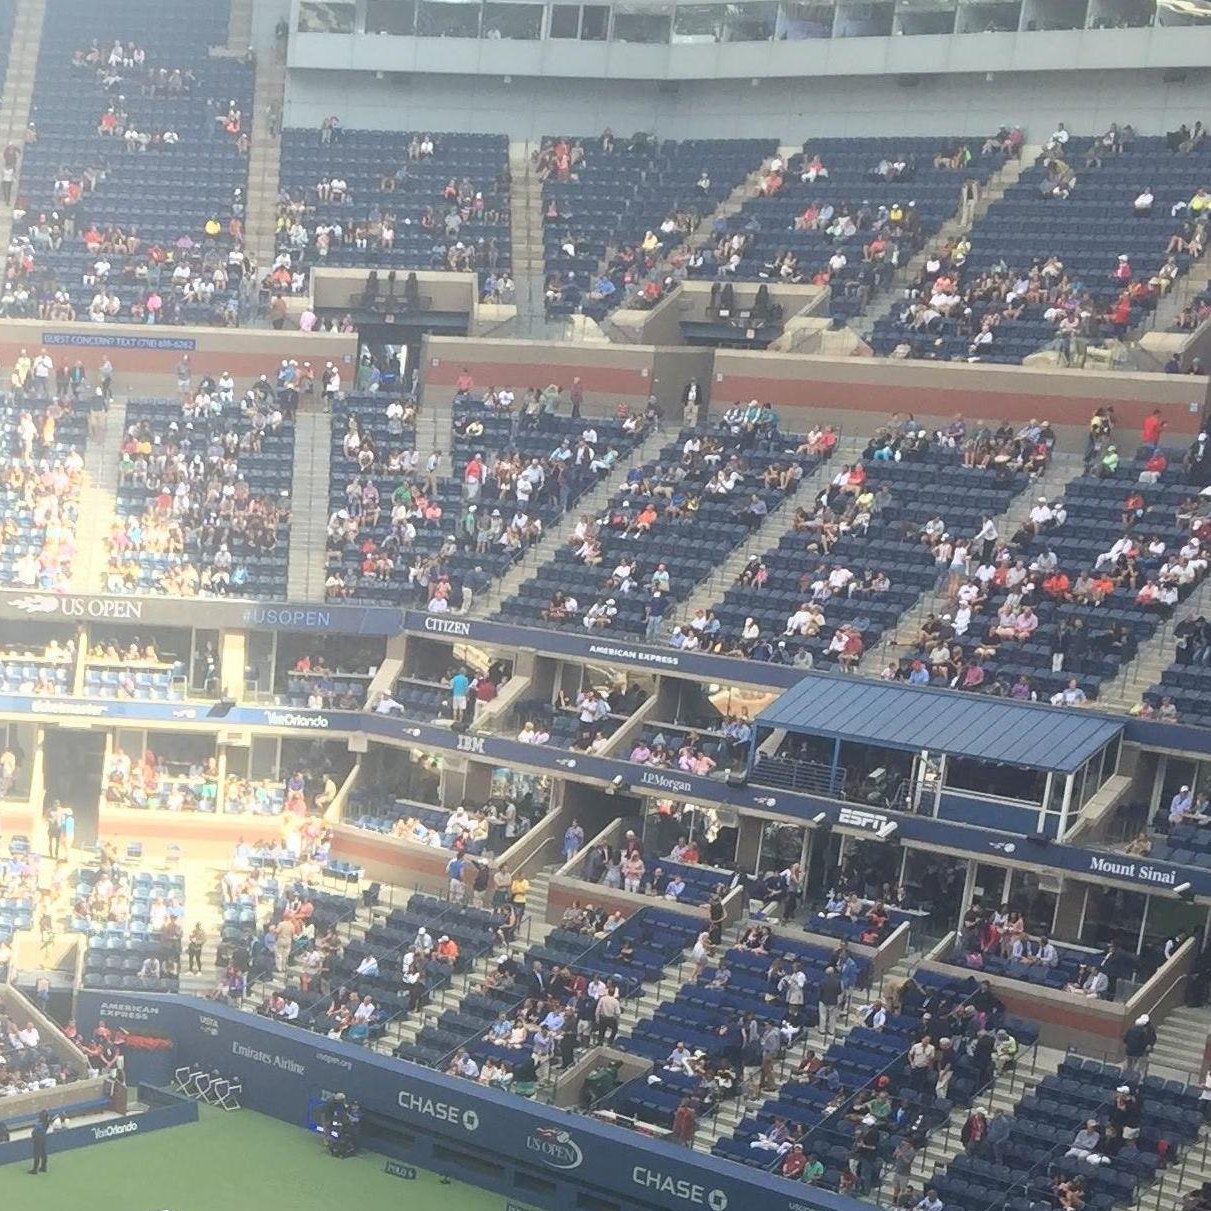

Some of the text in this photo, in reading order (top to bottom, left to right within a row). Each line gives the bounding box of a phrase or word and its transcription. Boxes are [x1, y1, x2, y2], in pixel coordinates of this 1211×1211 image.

[44, 335, 70, 344] GUEST
[116, 337, 137, 347] TEXT
[61, 597, 142, 618] US OPEN
[243, 608, 330, 626] #USOPEN
[425, 617, 470, 635] CITIZEN
[589, 645, 679, 665] AMERICAN EXPRESS
[457, 734, 485, 753] IBM
[1090, 857, 1177, 884] Mount Sinai
[100, 1002, 159, 1014] AMERICAN
[100, 1009, 149, 1020] EXPRESS
[232, 1041, 304, 1076] Emirates Airline
[398, 1091, 459, 1123] CHASE
[526, 1136, 576, 1163] US OPEN
[632, 1166, 705, 1205] CHASE
